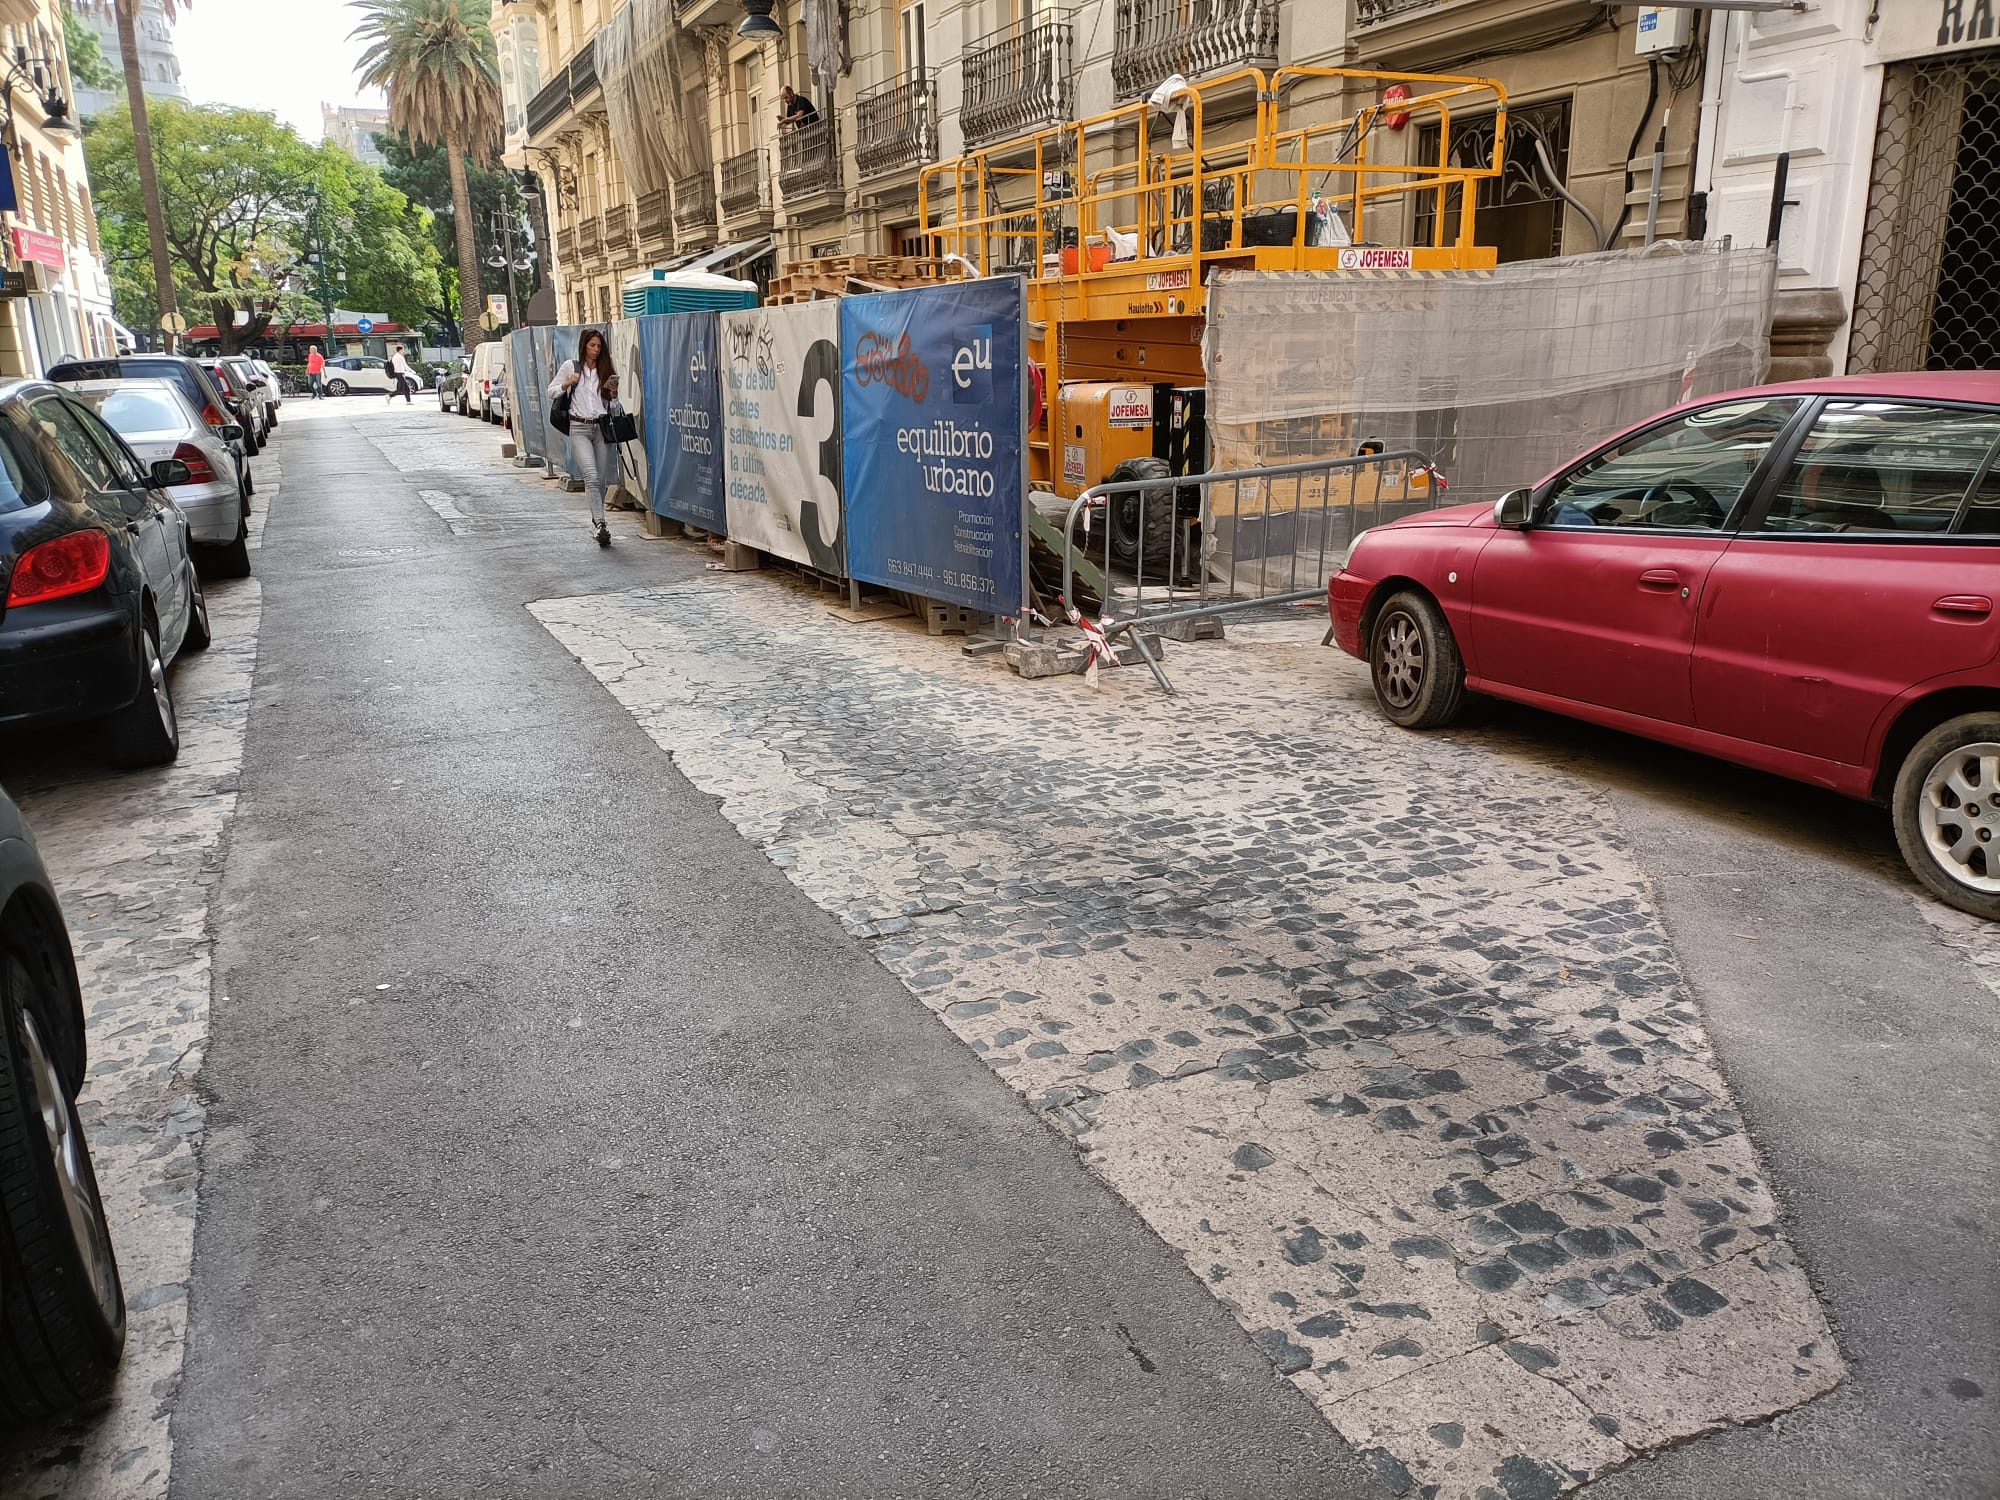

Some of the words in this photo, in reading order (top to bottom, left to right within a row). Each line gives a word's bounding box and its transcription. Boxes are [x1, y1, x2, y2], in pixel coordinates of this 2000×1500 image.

[1936, 0, 2000, 46] RA
[1359, 250, 1409, 268] JOFEMESA
[1158, 270, 1188, 288] JOFEMESA
[1128, 302, 1154, 314] Haulotte
[690, 351, 706, 382] eu
[952, 338, 992, 388] eu
[746, 367, 757, 390] de
[669, 404, 710, 432] equilibrio
[1111, 404, 1149, 417] JOFEMESA
[681, 429, 712, 455] urbano
[780, 433, 793, 452] en
[896, 420, 993, 462] equilibrio
[730, 450, 738, 472] la
[797, 339, 841, 577] 3
[923, 459, 994, 497] urbano
[730, 478, 768, 504] década.
[958, 510, 994, 526] Promoción
[953, 524, 994, 541] Construcción
[953, 540, 993, 558] Rehabilitación
[887, 559, 934, 579] 663.847.444
[943, 570, 997, 595] 961.856.372
